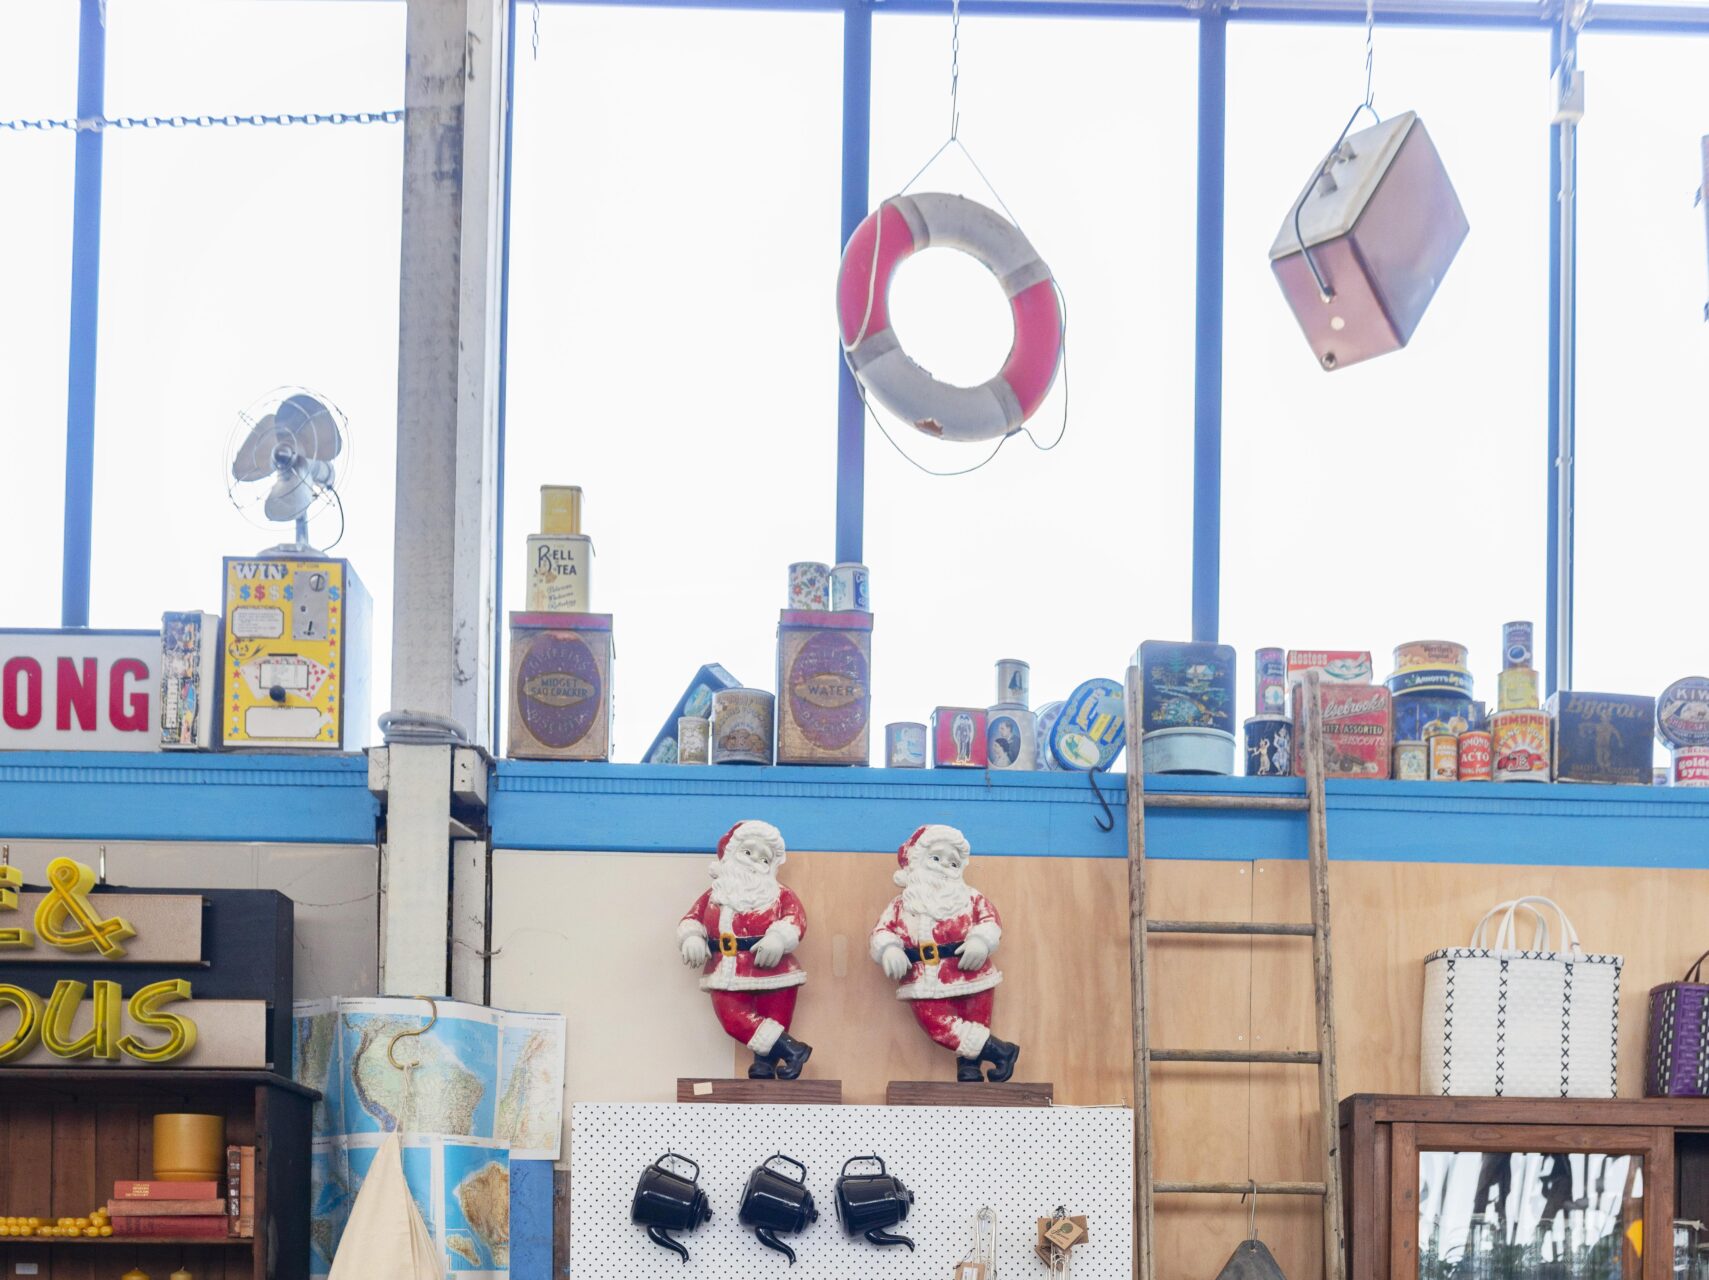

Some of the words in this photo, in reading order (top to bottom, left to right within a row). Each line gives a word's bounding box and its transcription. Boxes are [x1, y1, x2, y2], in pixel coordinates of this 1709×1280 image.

[538, 545, 575, 573] BELL
[237, 563, 288, 580] WIN
[556, 565, 577, 575] TEA
[1289, 650, 1328, 665] Hostess
[541, 678, 577, 687] MIDGET
[3, 656, 150, 732] ONG
[551, 688, 588, 698] CRACKER
[808, 685, 855, 696] WATER
[1343, 724, 1384, 735] ASSORTED
[1461, 751, 1489, 762] ACTO
[34, 857, 137, 960] &
